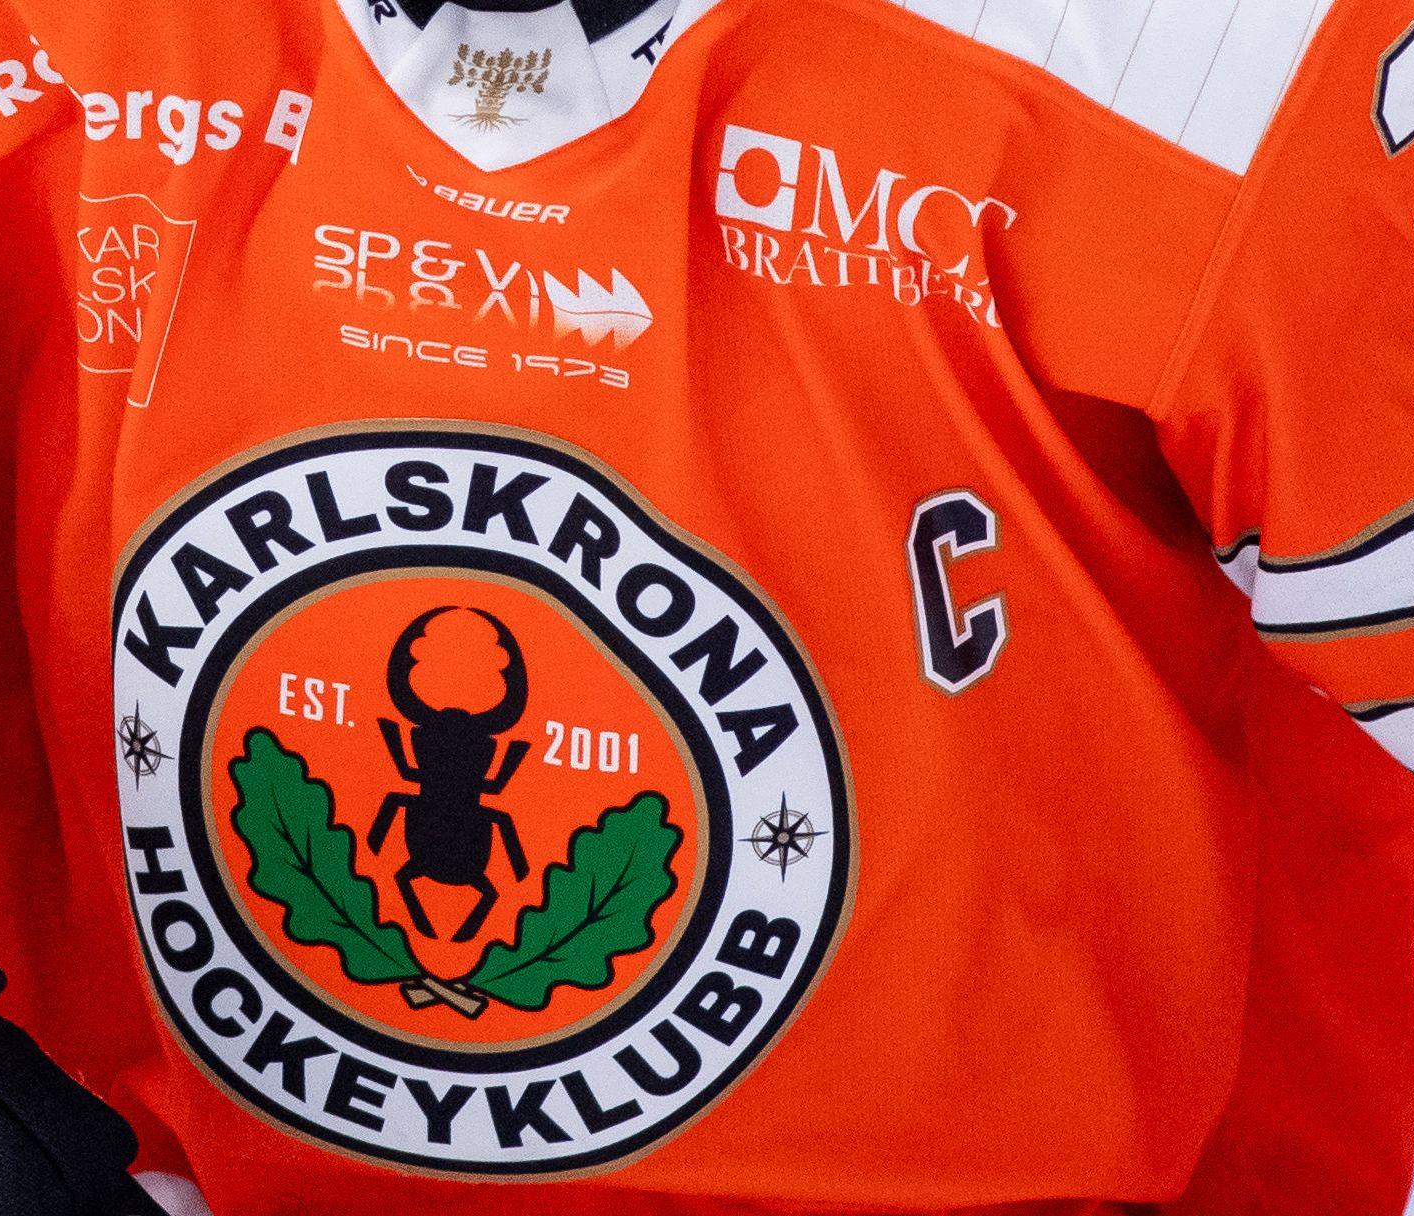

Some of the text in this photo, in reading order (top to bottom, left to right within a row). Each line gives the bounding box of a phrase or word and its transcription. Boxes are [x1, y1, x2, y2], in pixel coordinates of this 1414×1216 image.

[77, 265, 157, 304] SK
[340, 325, 631, 390] SINCE 1973
[123, 460, 802, 778] KARLSKRONA
[908, 487, 1009, 698] C
[279, 672, 357, 729] EST.
[542, 720, 641, 776] 2001
[126, 824, 803, 1149] HOCKEYKLUBB
